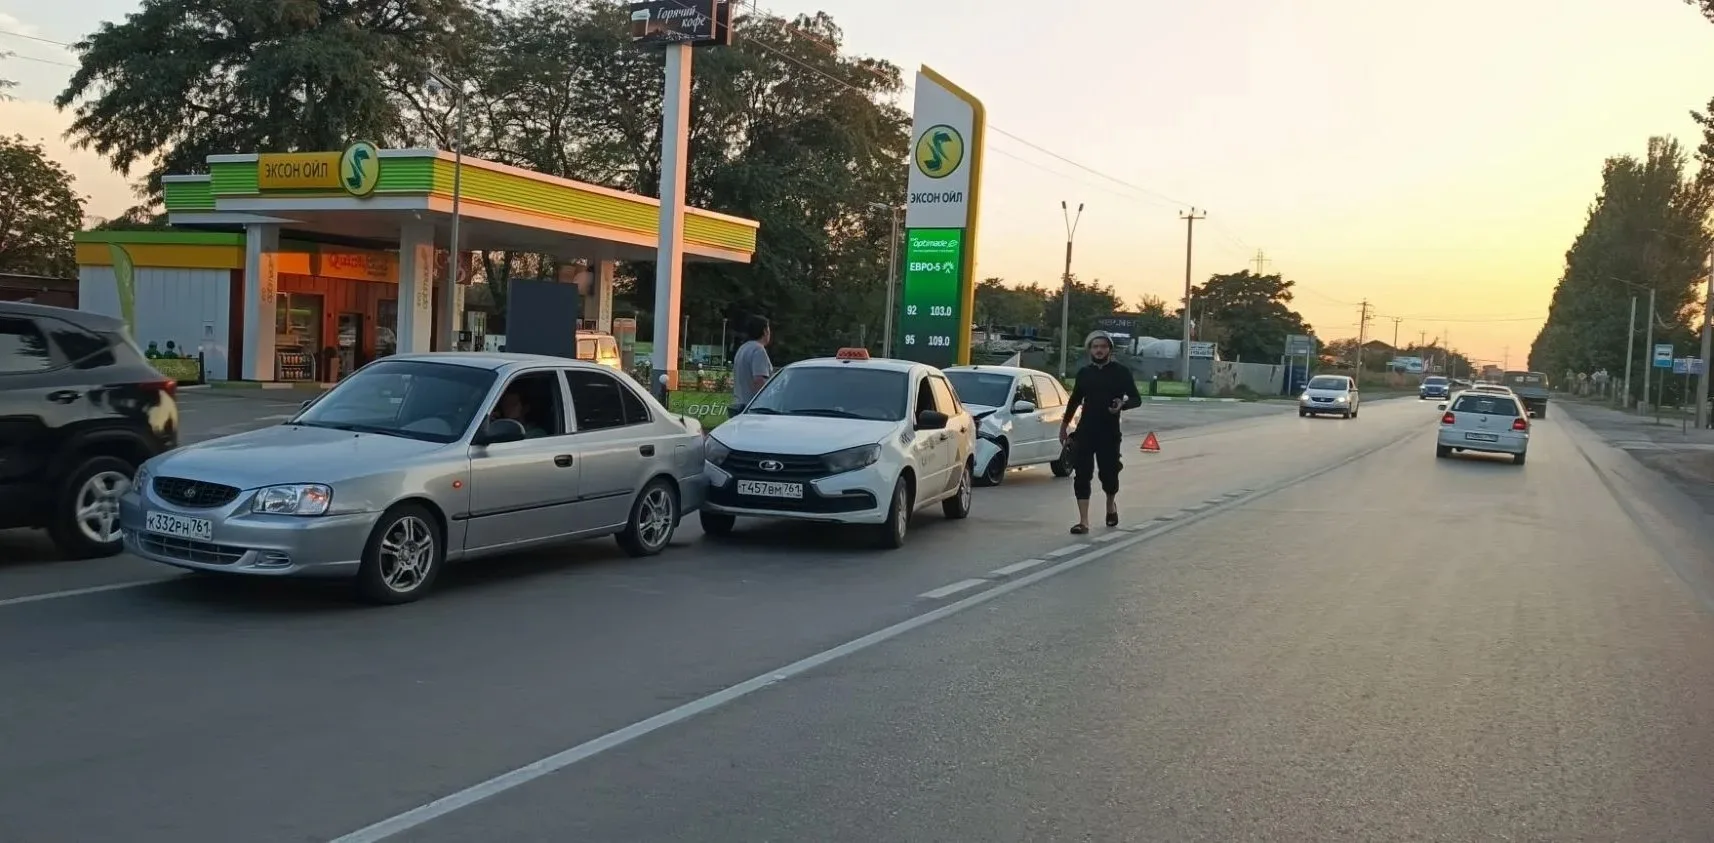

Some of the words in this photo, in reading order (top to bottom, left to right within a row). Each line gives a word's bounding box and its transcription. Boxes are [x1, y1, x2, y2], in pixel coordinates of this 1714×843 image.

[657, 5, 697, 24] Горячий
[681, 14, 706, 32] кофе
[265, 162, 300, 178] ЭКСОН
[303, 160, 328, 178] ОЙЛ
[910, 192, 940, 203] ЭКСОН
[942, 190, 963, 203] ОЙЛ
[910, 262, 941, 271] ЕВРО-5
[907, 305, 917, 315] 92
[930, 306, 952, 316] 103.0
[905, 334, 915, 345] 95
[928, 335, 950, 346] 109.0
[688, 402, 727, 418] opti
[148, 514, 189, 535] К332РН
[192, 519, 210, 534] 761
